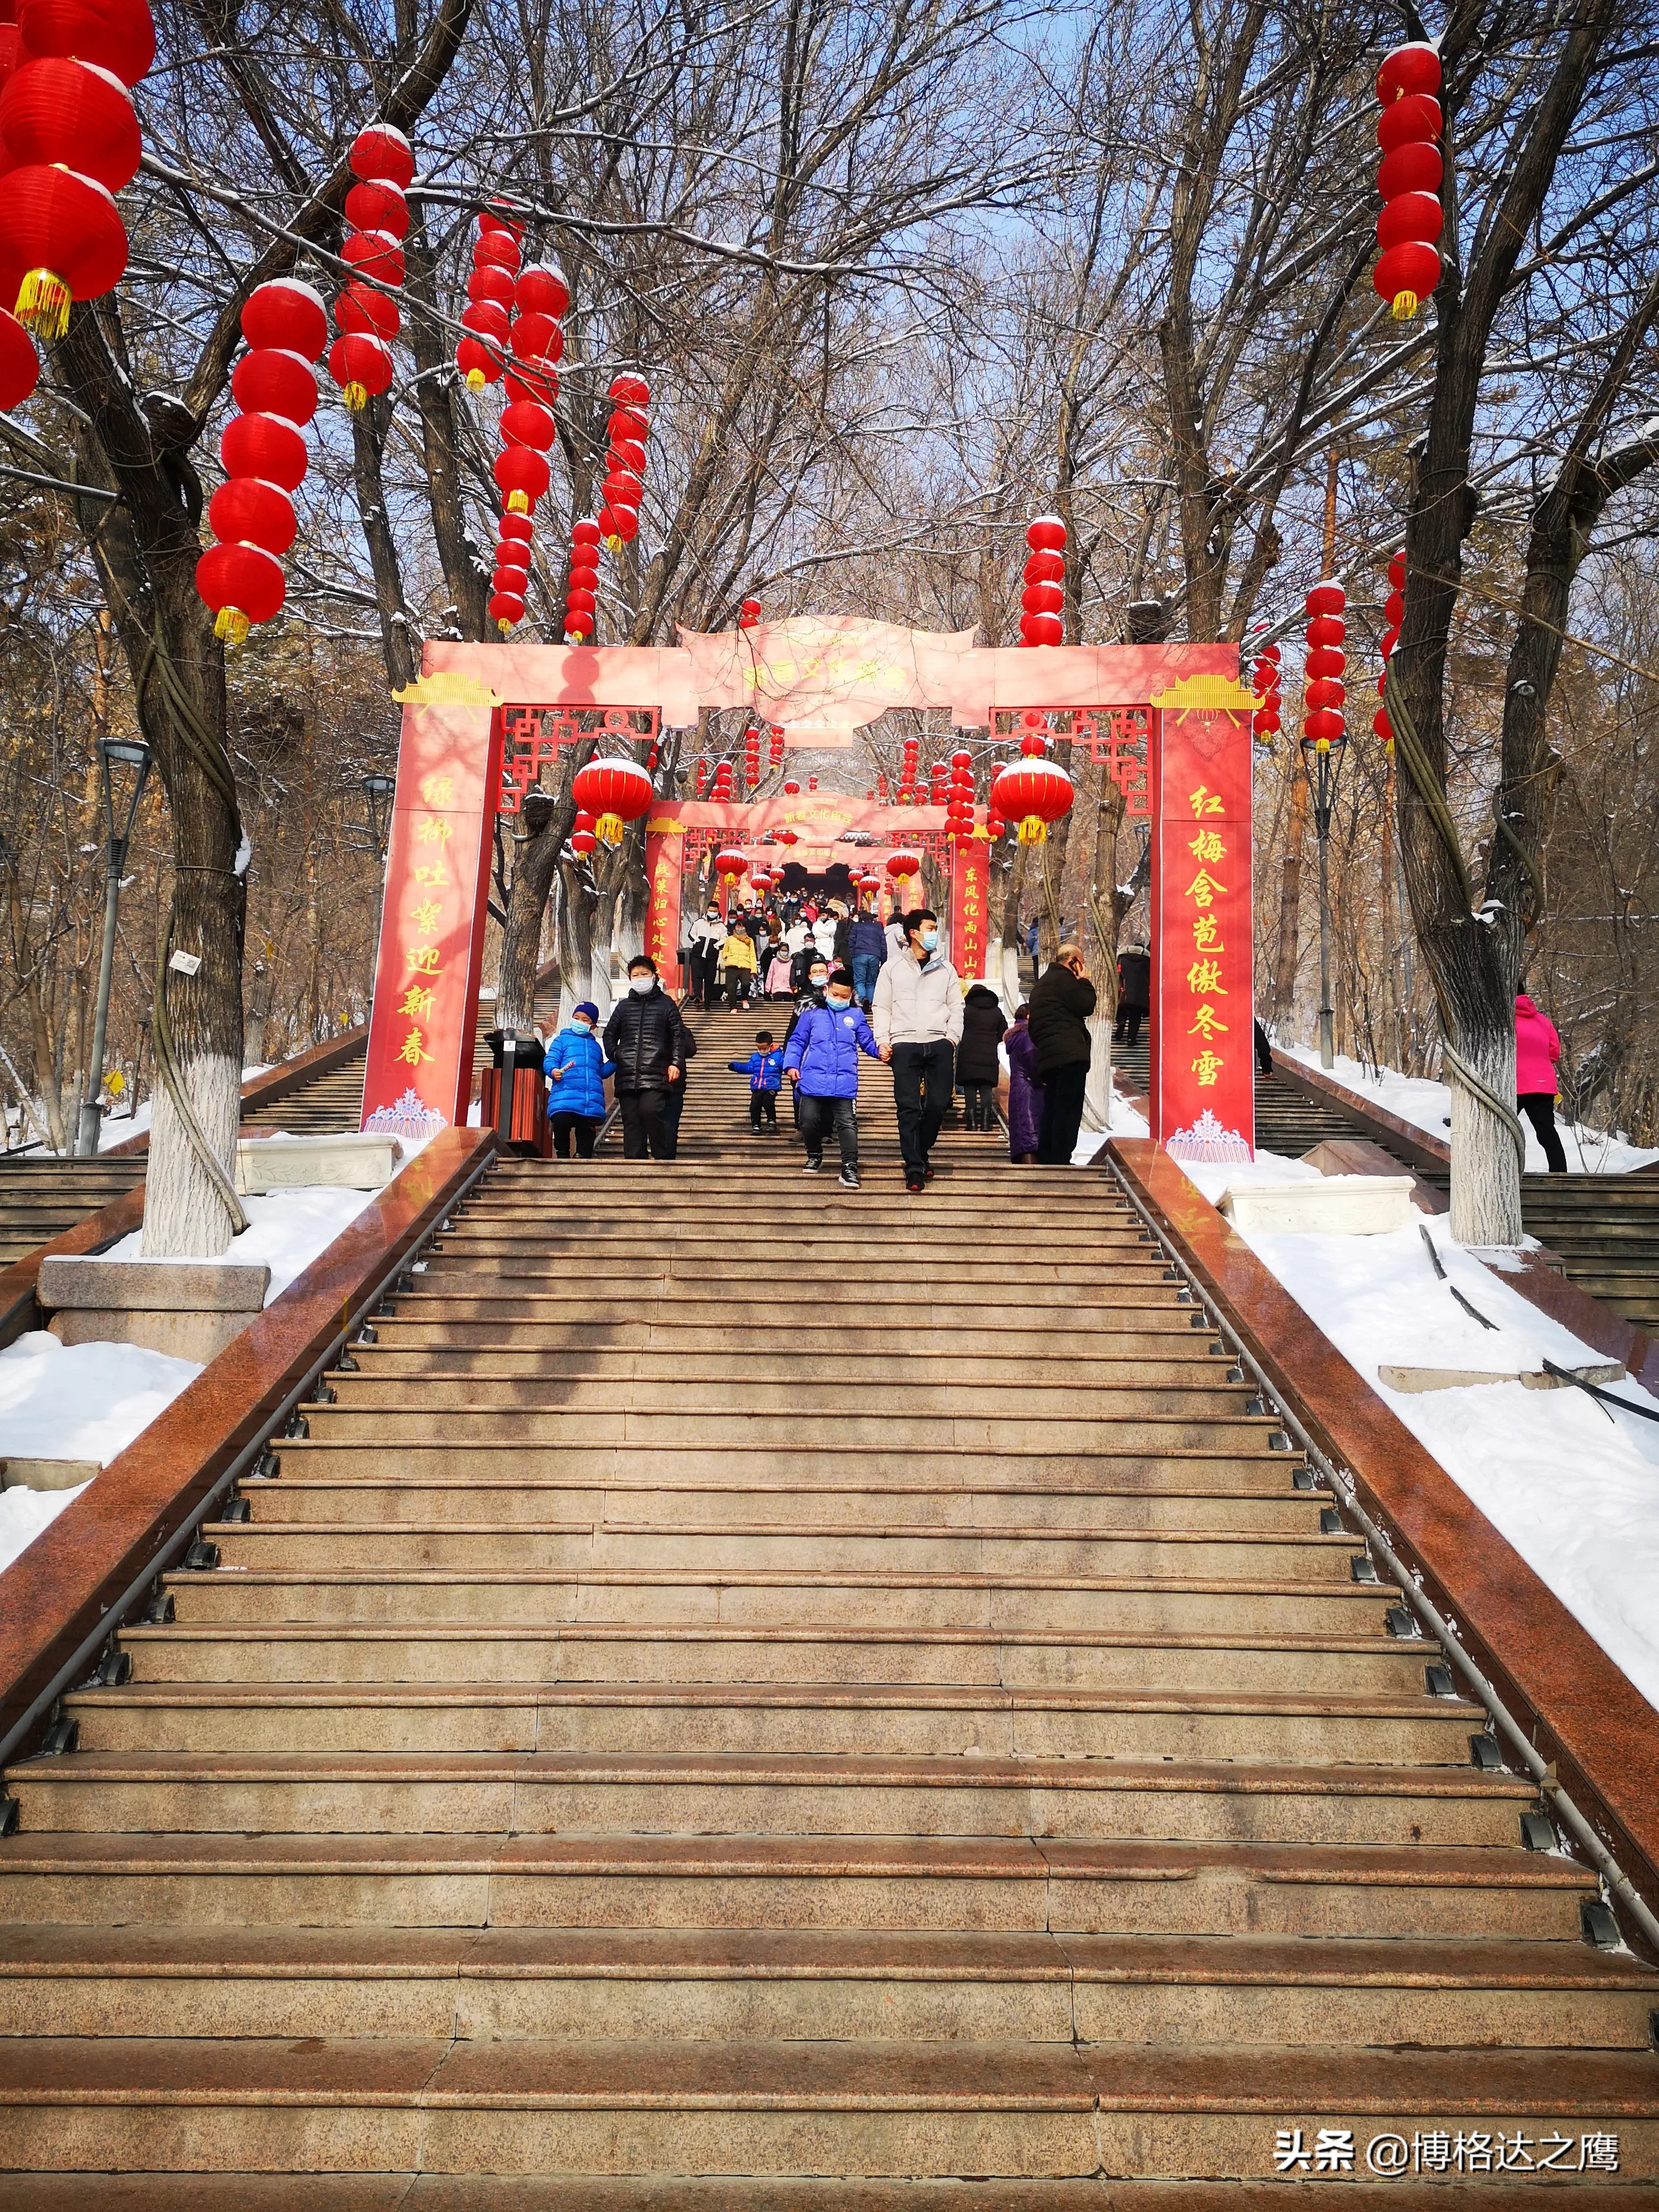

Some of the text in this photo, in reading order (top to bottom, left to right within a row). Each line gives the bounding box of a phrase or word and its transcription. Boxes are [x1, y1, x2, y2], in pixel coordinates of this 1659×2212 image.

[394, 777, 453, 1065] 绿柳吐絮迎新春
[784, 809, 853, 823] 新春文化庙会
[1185, 785, 1229, 1086] 红梅含苞傲冬雪
